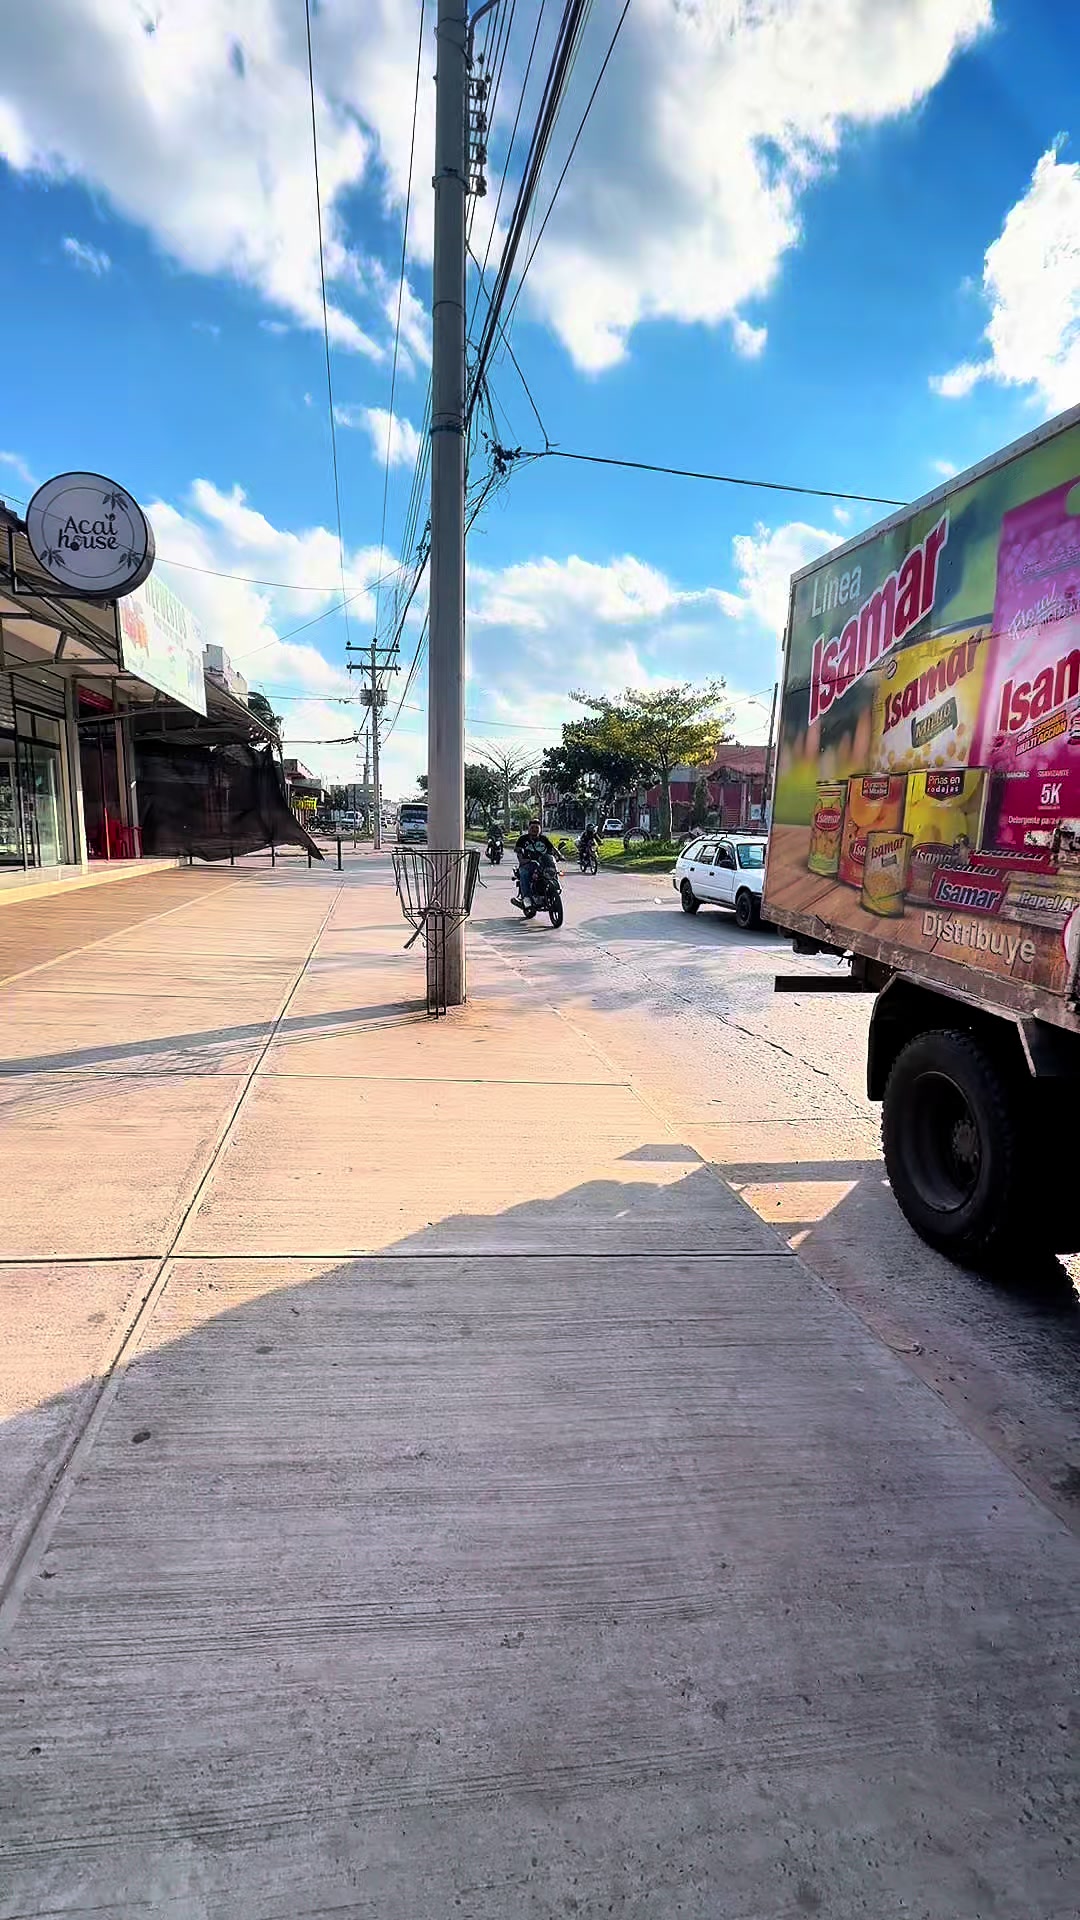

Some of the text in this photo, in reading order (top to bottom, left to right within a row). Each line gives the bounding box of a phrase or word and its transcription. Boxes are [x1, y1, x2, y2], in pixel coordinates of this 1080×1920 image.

[58, 528, 119, 551] house
[808, 512, 949, 725] Isamar
[883, 629, 983, 735] Isamar
[997, 646, 1080, 733] Isam
[927, 785, 959, 794] rodajas
[950, 776, 961, 785] en
[1040, 783, 1062, 805] 5K
[853, 843, 867, 856] Isa
[871, 837, 905, 859] Isamar
[915, 849, 953, 866] Isama
[935, 876, 1001, 910] Isamar
[1020, 891, 1060, 912] Papel
[921, 911, 1036, 966] Distribuye
